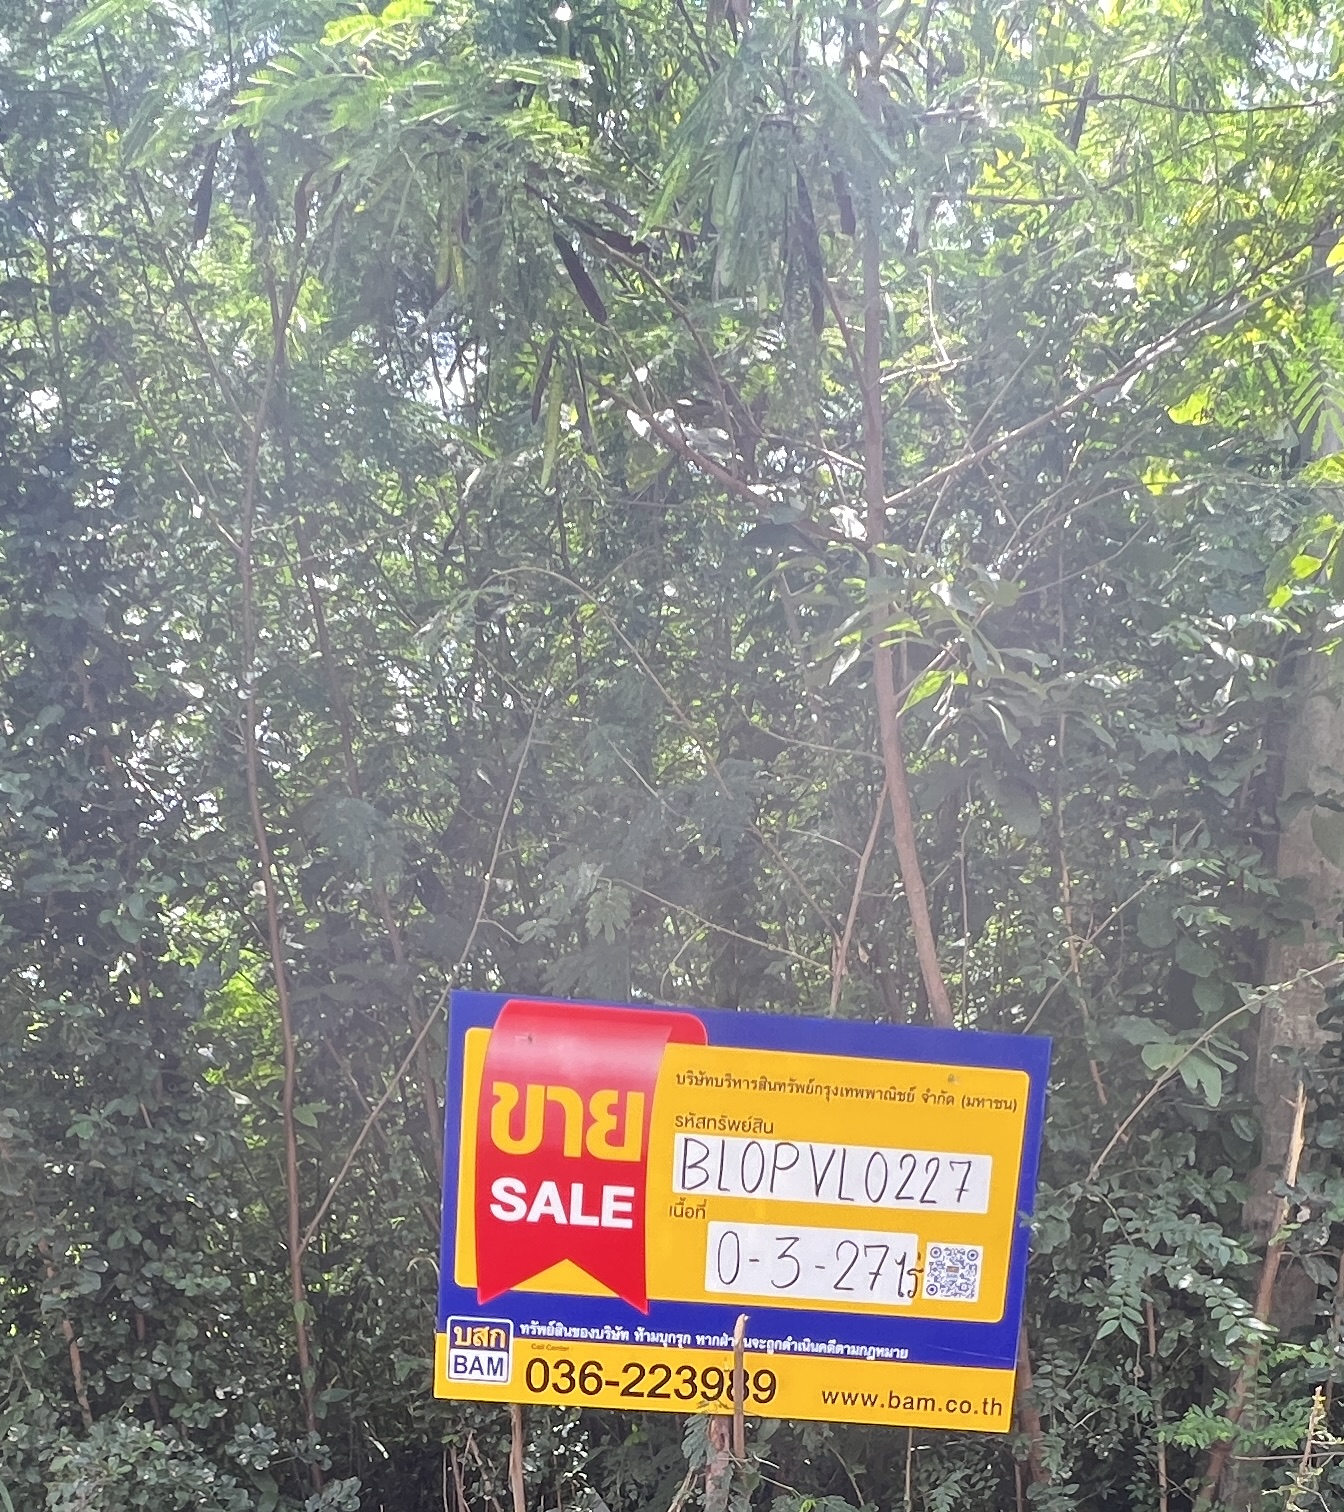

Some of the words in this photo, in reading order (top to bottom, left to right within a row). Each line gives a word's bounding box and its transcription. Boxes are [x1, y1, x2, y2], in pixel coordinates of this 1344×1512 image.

[676, 1069, 916, 1103] บริษัทบริหารสินทรัพย์กรุงเทพพาณิชย์
[921, 1088, 955, 1106] จำกัด
[961, 1095, 1017, 1113] (มหาชน)
[490, 1081, 645, 1162] ขาย
[674, 1112, 774, 1135] รหัสทรัพย์สิน
[489, 1177, 636, 1229] SALE
[669, 1197, 707, 1220] เนื้อที่
[453, 1324, 506, 1349] บสก
[519, 1320, 630, 1342] ทรัพย์สินของบริษัท
[633, 1326, 691, 1349] ห้ามบุกรุก
[695, 1332, 910, 1361] หากฝ่านจะถูกดำเนินคดีตามกฎหมาย
[453, 1355, 504, 1377] BAM
[525, 1357, 777, 1404] 036-223989
[821, 1389, 1003, 1417] www.bam.co.th
